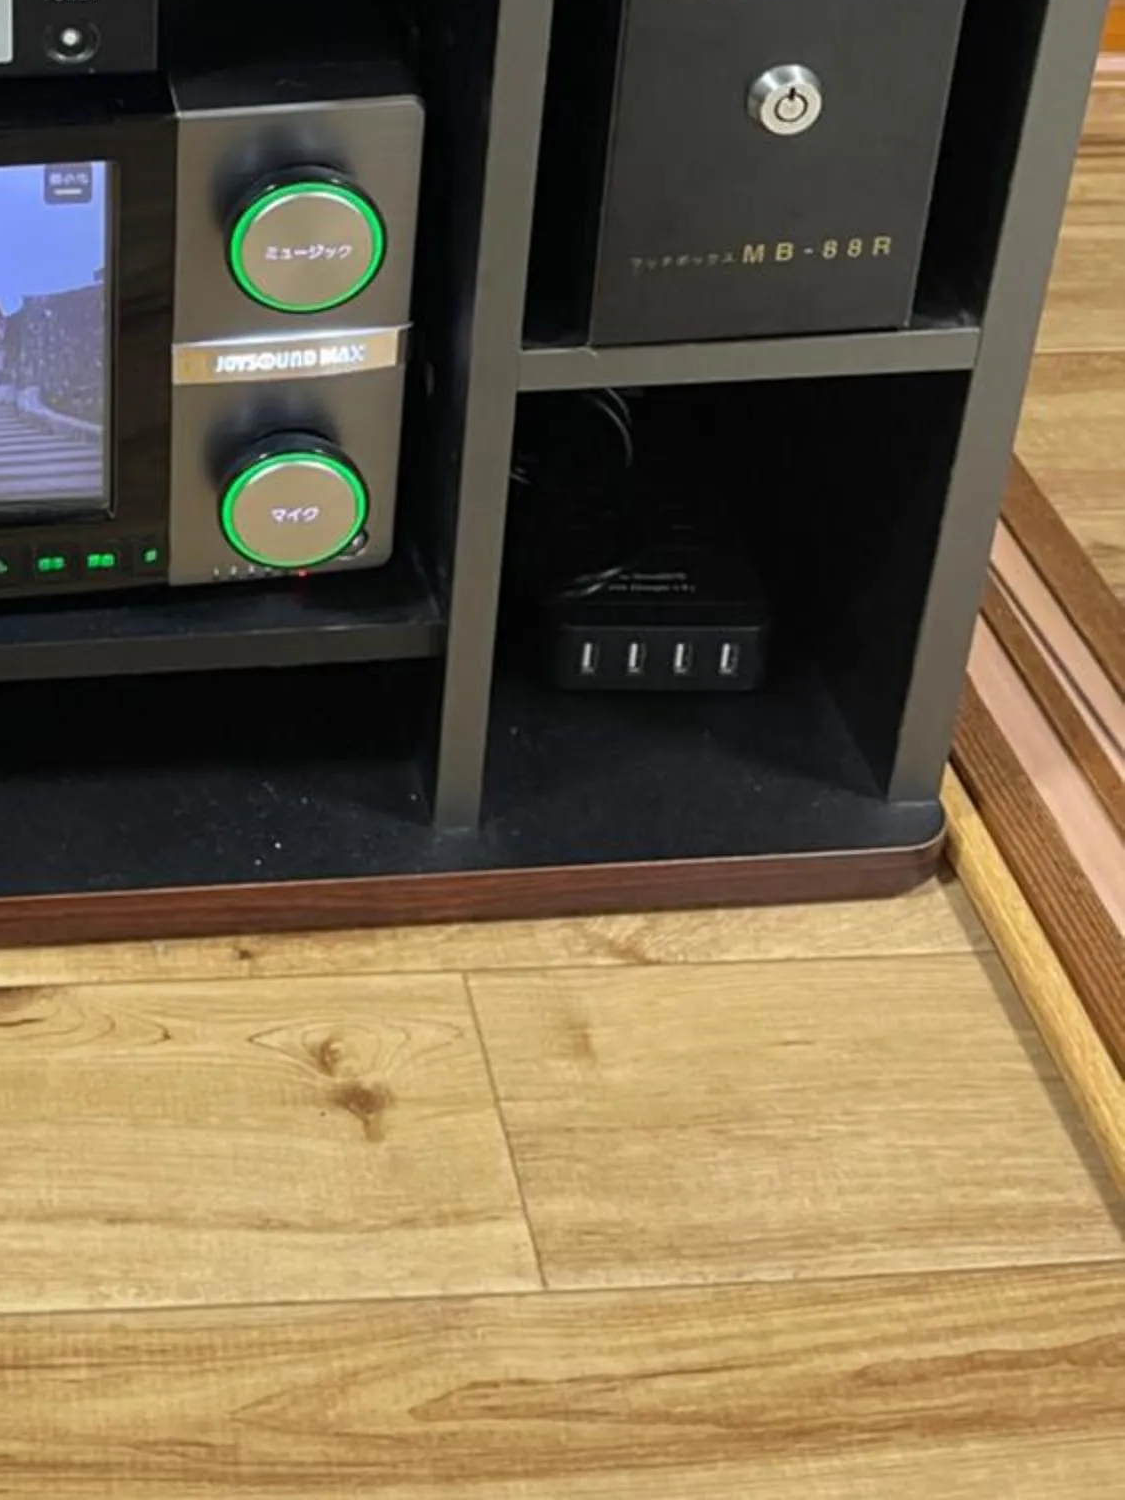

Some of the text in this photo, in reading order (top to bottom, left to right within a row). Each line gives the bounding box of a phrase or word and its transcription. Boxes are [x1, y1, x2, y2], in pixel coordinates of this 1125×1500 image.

[265, 243, 354, 261] ミュージック
[215, 345, 366, 373] JOYSOUND MAX
[271, 506, 320, 523] マイク
